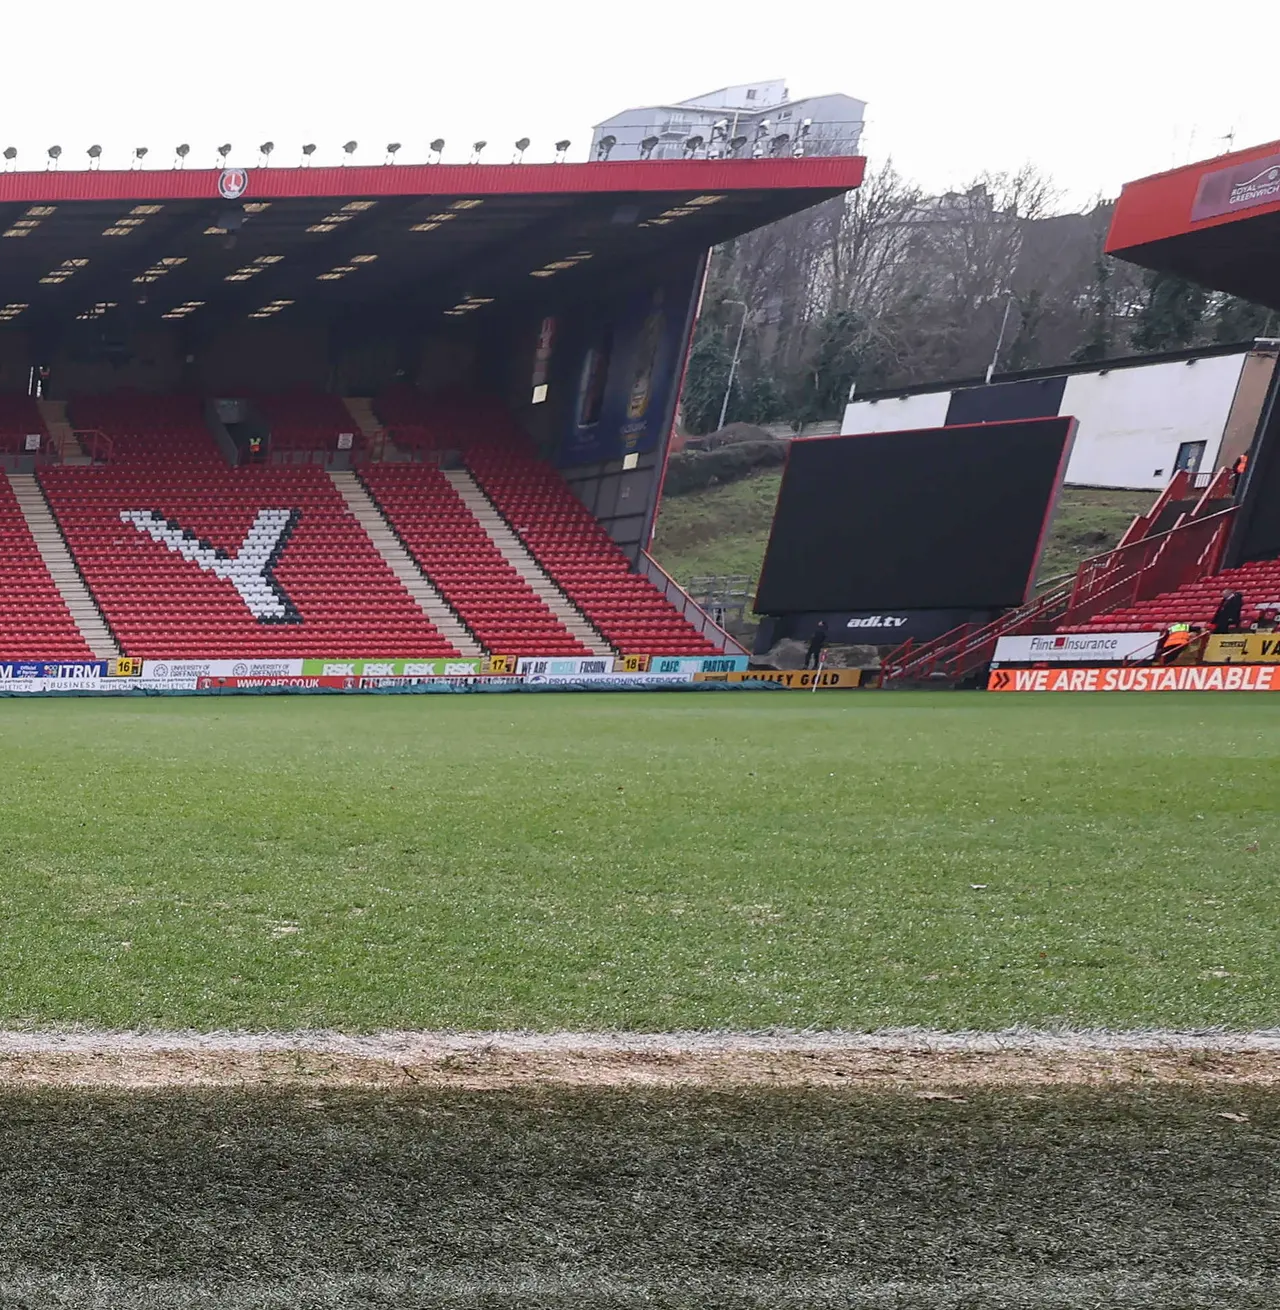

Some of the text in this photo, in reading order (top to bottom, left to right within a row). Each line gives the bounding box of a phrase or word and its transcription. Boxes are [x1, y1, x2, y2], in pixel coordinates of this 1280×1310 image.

[1229, 185, 1280, 204] GREENWICH
[1231, 184, 1256, 197] ROYAL
[847, 616, 908, 627] adi.tv
[1030, 637, 1118, 650] Flint Insurance
[118, 662, 130, 672] 16
[493, 660, 504, 670] 17
[626, 659, 637, 669] 18
[58, 665, 101, 677] ITRM
[800, 673, 840, 686] GOLD
[1015, 667, 1275, 690] WE ARE SUSTAINABLE
